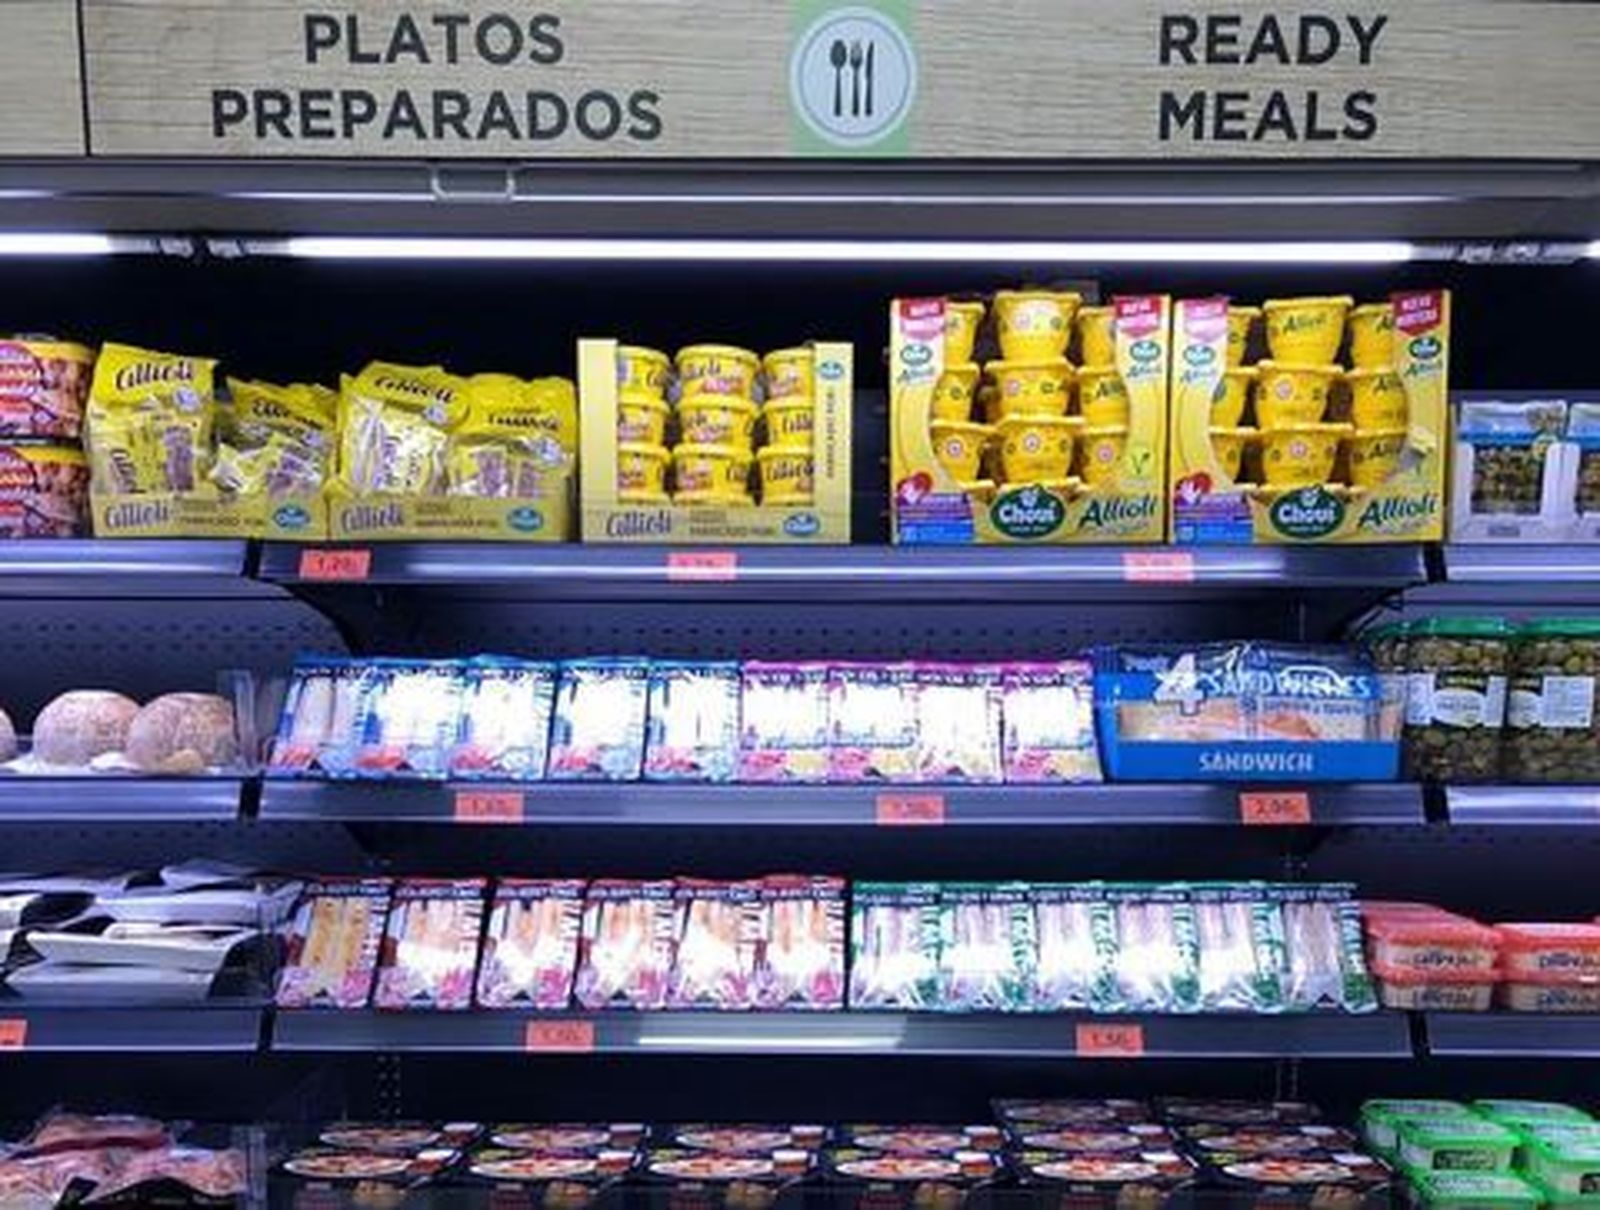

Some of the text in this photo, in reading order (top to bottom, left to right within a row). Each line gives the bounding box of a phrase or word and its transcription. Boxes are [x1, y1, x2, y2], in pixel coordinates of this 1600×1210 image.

[304, 13, 565, 65] PLATOS
[1158, 14, 1388, 65] READY
[211, 89, 663, 140] PREPARADOS
[1158, 89, 1378, 141] MEALS
[1076, 494, 1158, 530] Allioli
[1357, 491, 1439, 528] Allioli
[1200, 752, 1313, 773] SANDWICH
